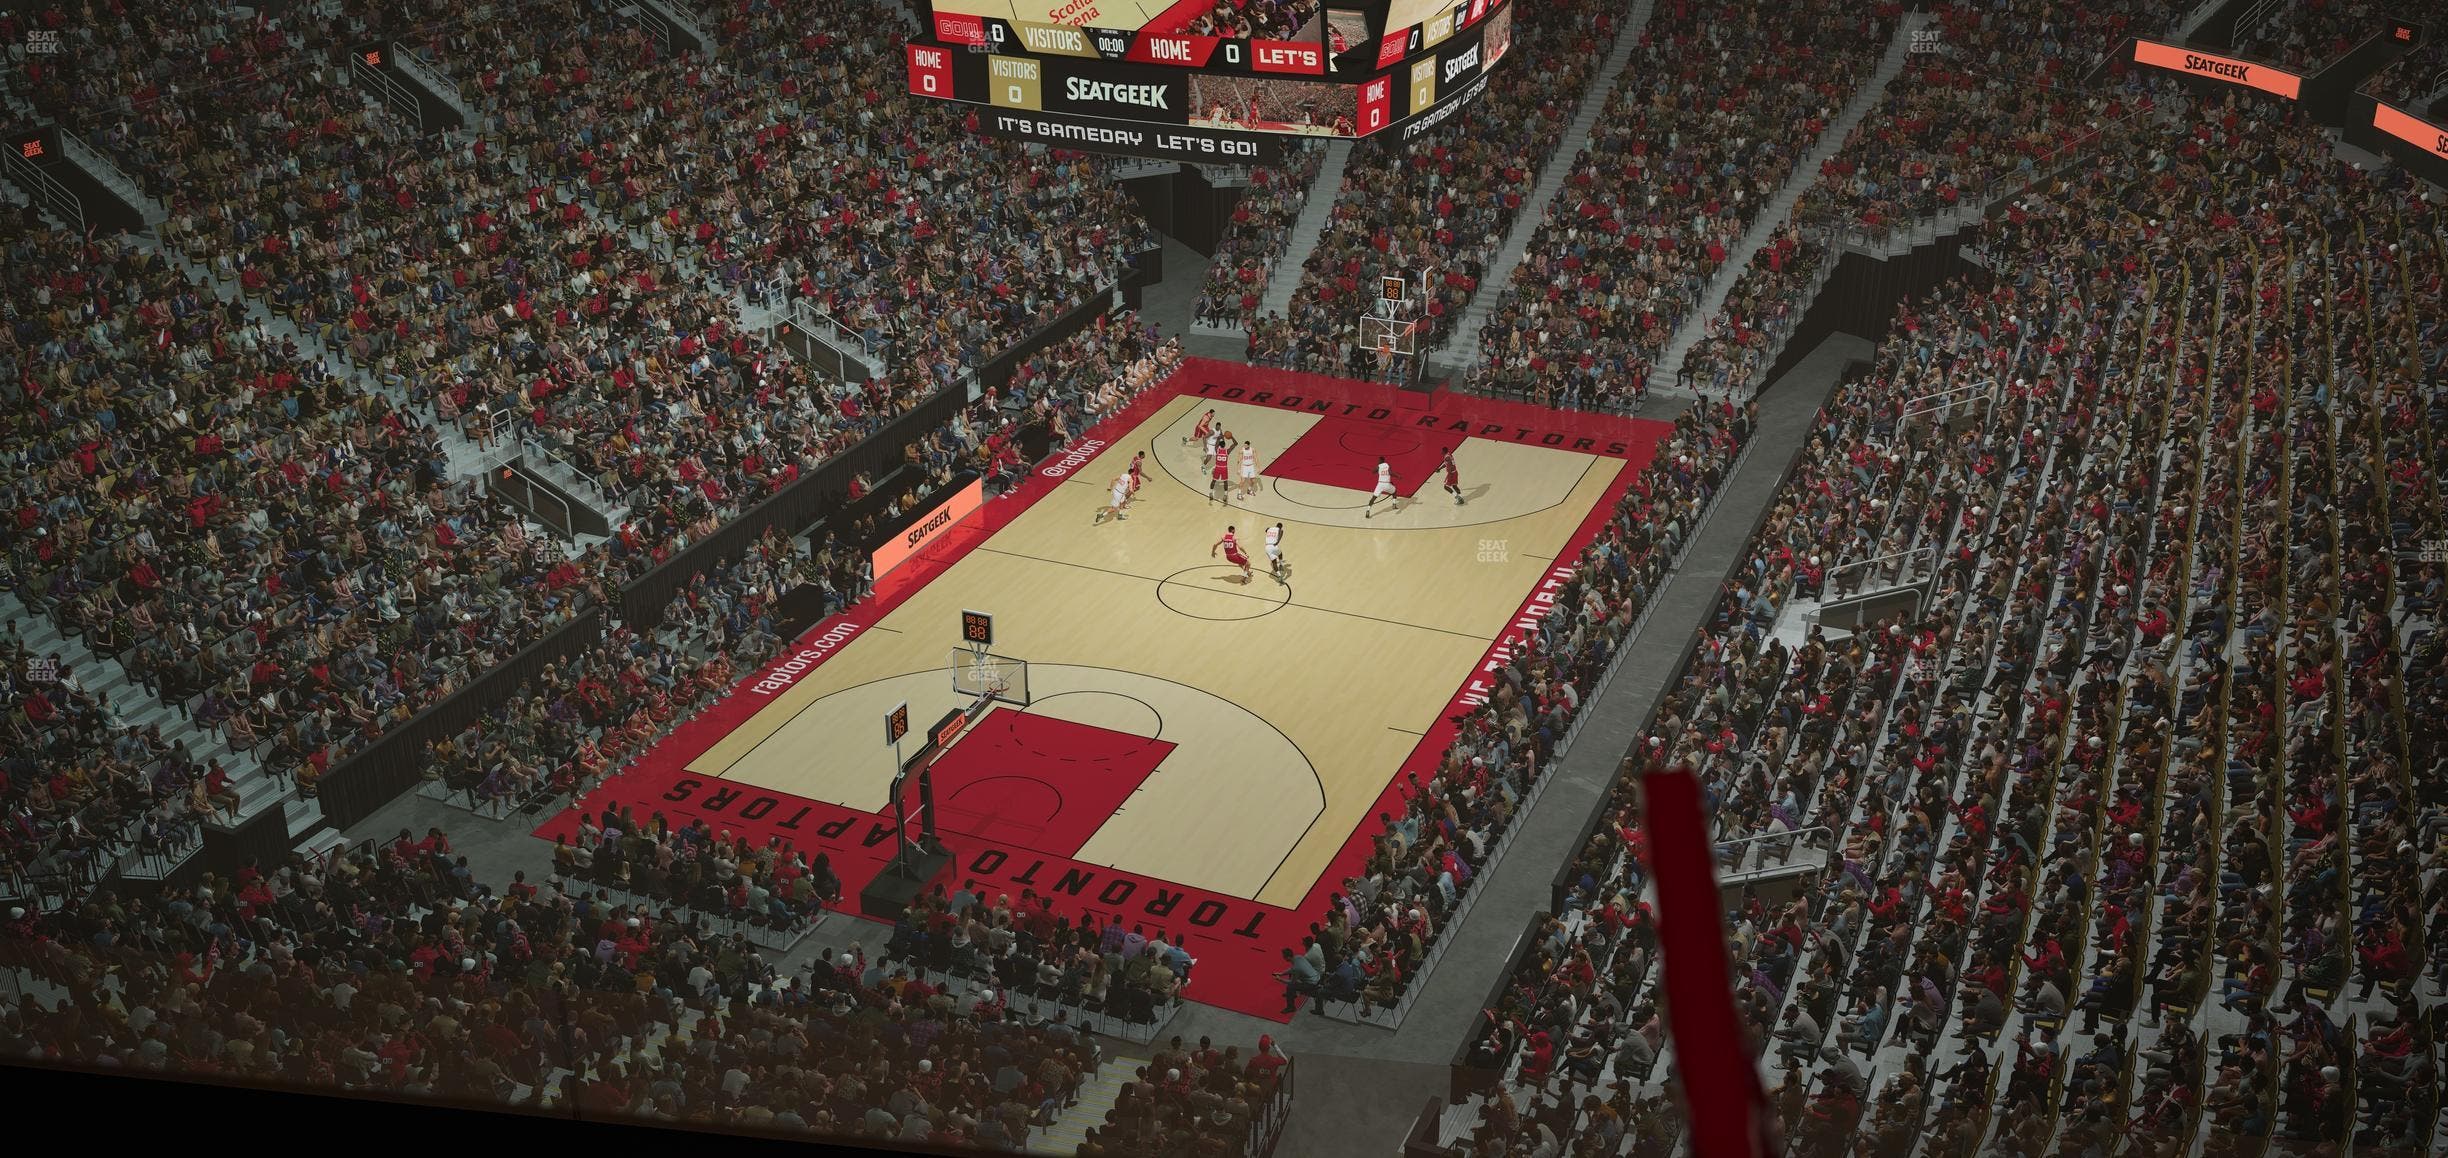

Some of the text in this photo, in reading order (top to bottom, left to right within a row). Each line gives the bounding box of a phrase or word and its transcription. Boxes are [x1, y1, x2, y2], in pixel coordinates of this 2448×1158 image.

[991, 23, 1005, 43] 0
[1025, 27, 1083, 52] VISITORS
[1098, 37, 1124, 53] 00:00
[915, 50, 942, 69] HOME
[1150, 38, 1240, 64] HOME 0
[1259, 48, 1318, 66] LET'S
[1444, 41, 1480, 84] SEATGEEK
[992, 59, 1037, 81] VISITORS
[2184, 54, 2250, 83] SEATGEEK
[923, 74, 937, 93] 0
[1008, 85, 1022, 104] 0
[1066, 76, 1168, 110] SEATGEEK
[1366, 80, 1385, 104] HOME
[1370, 107, 1380, 128] 0
[997, 116, 1258, 157] IT'S GAMEDAY LET'S GO!
[1199, 383, 1628, 455] TORONTO RAPTORS
[1041, 438, 1106, 478] @raptors
[907, 505, 952, 549] SEATGEEK
[751, 621, 860, 695] raptors.com
[663, 780, 1265, 938] TORONTO APTORS
